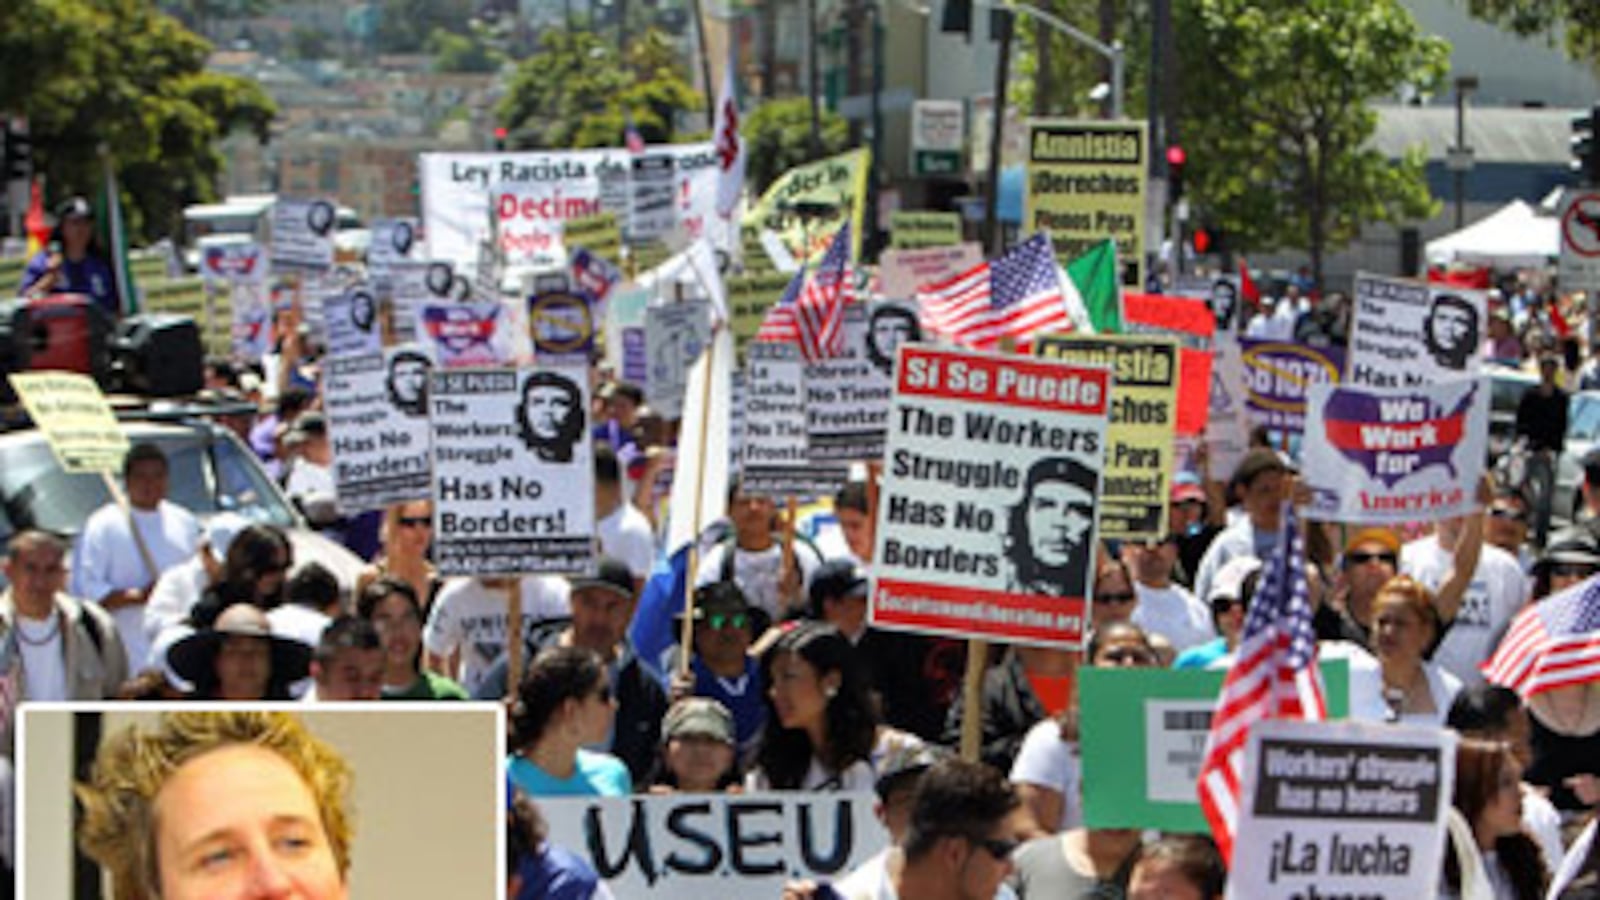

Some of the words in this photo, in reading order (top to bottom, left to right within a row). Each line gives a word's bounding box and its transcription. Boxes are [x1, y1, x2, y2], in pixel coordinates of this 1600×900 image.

[452, 162, 489, 188] Ley
[501, 157, 586, 181] Racista
[947, 361, 988, 394] Se
[996, 366, 1100, 405] Puede
[1353, 363, 1399, 388] Has
[434, 400, 468, 414] The
[808, 388, 836, 403] No
[809, 409, 889, 425] Fronter
[1380, 400, 1425, 422] We
[898, 404, 953, 437] The
[965, 411, 1099, 454] Workers
[1361, 424, 1437, 449] Work
[335, 437, 375, 456] Has
[380, 430, 411, 449] No
[435, 445, 514, 465] Struggle
[1115, 443, 1159, 468] Para
[892, 450, 1019, 489] Struggle
[1376, 452, 1420, 474] for
[440, 477, 493, 501] Has
[501, 476, 544, 500] No
[1359, 488, 1464, 510] America
[440, 509, 567, 534] Borders!
[887, 495, 947, 528] Has
[954, 502, 994, 533] No
[883, 540, 999, 577] Borders
[1266, 749, 1356, 780] Workers'
[1357, 753, 1436, 788] struggle
[1276, 782, 1314, 810] has
[1318, 789, 1344, 811] no
[1346, 783, 1420, 815] borders
[1268, 832, 1319, 883] ¡La
[1329, 834, 1412, 875] lucha
